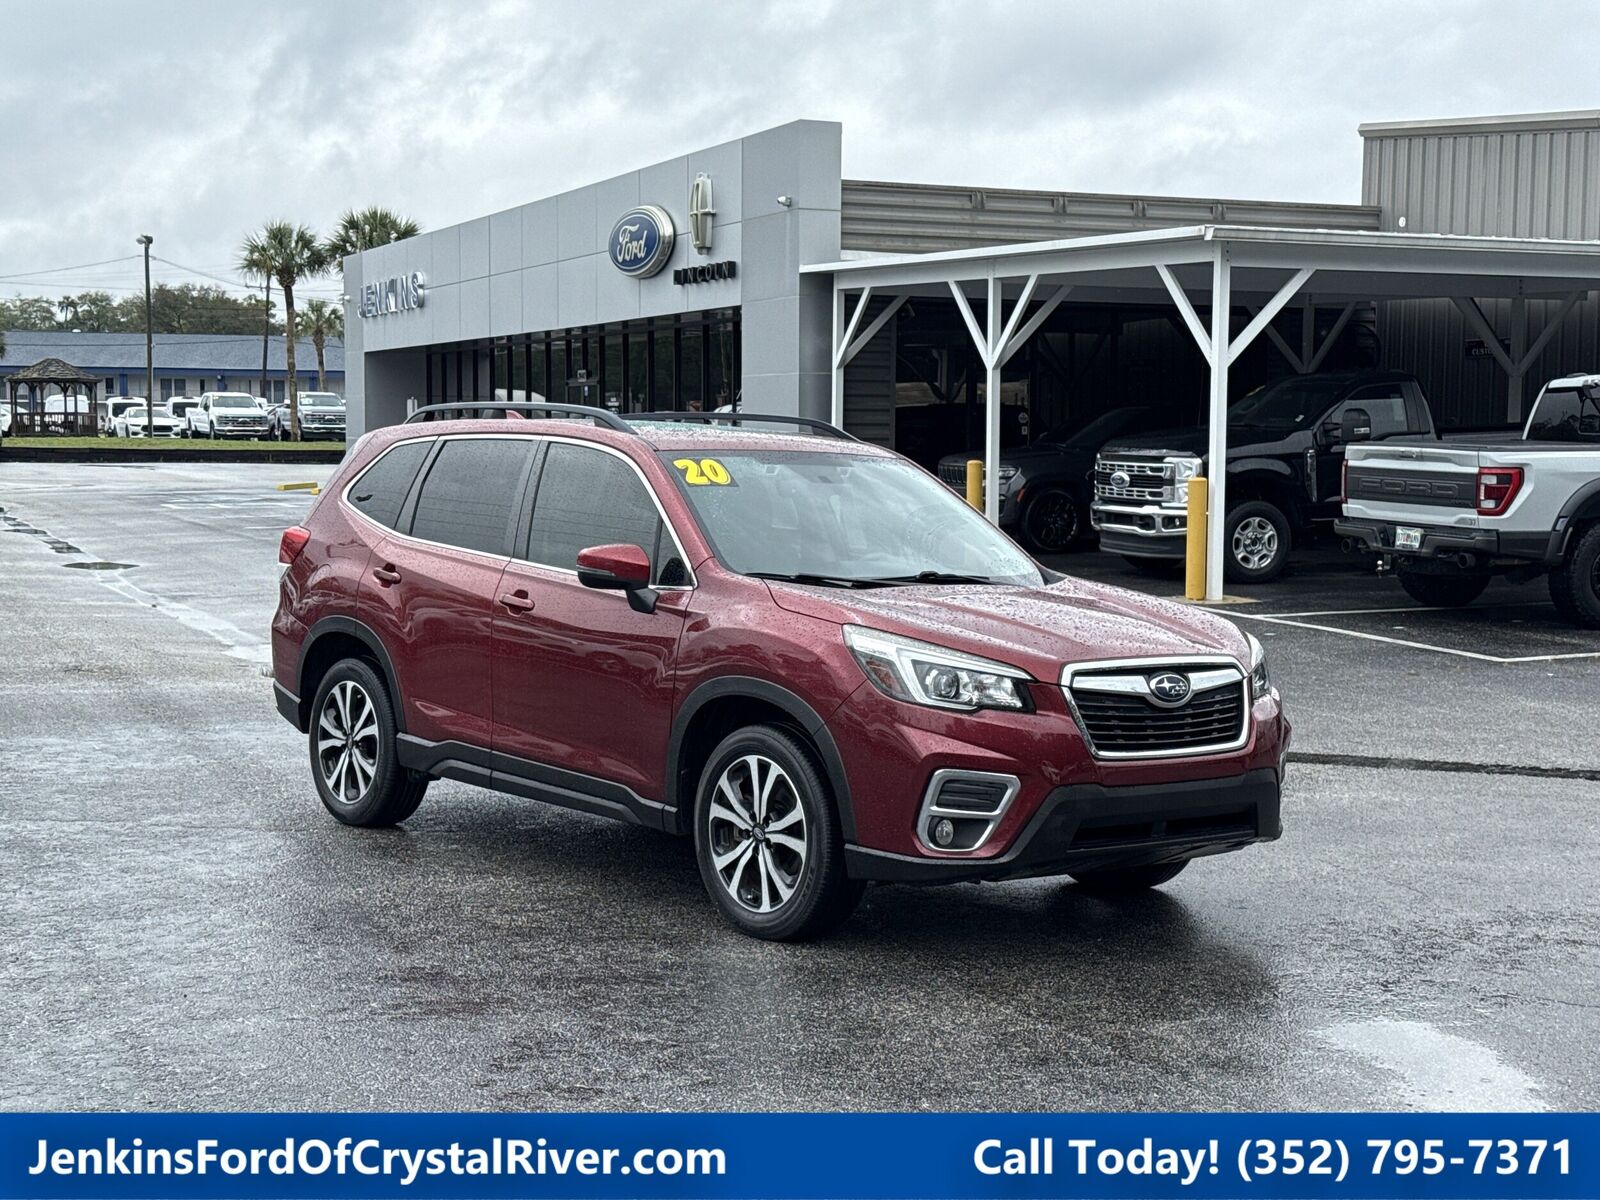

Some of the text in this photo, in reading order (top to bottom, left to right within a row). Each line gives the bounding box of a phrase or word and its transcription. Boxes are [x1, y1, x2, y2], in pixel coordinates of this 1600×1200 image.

[616, 223, 648, 263] Ford
[673, 260, 736, 285] LINCOLN
[357, 271, 425, 318] JENKINS
[672, 458, 731, 486] 20
[1359, 477, 1460, 499] FORD
